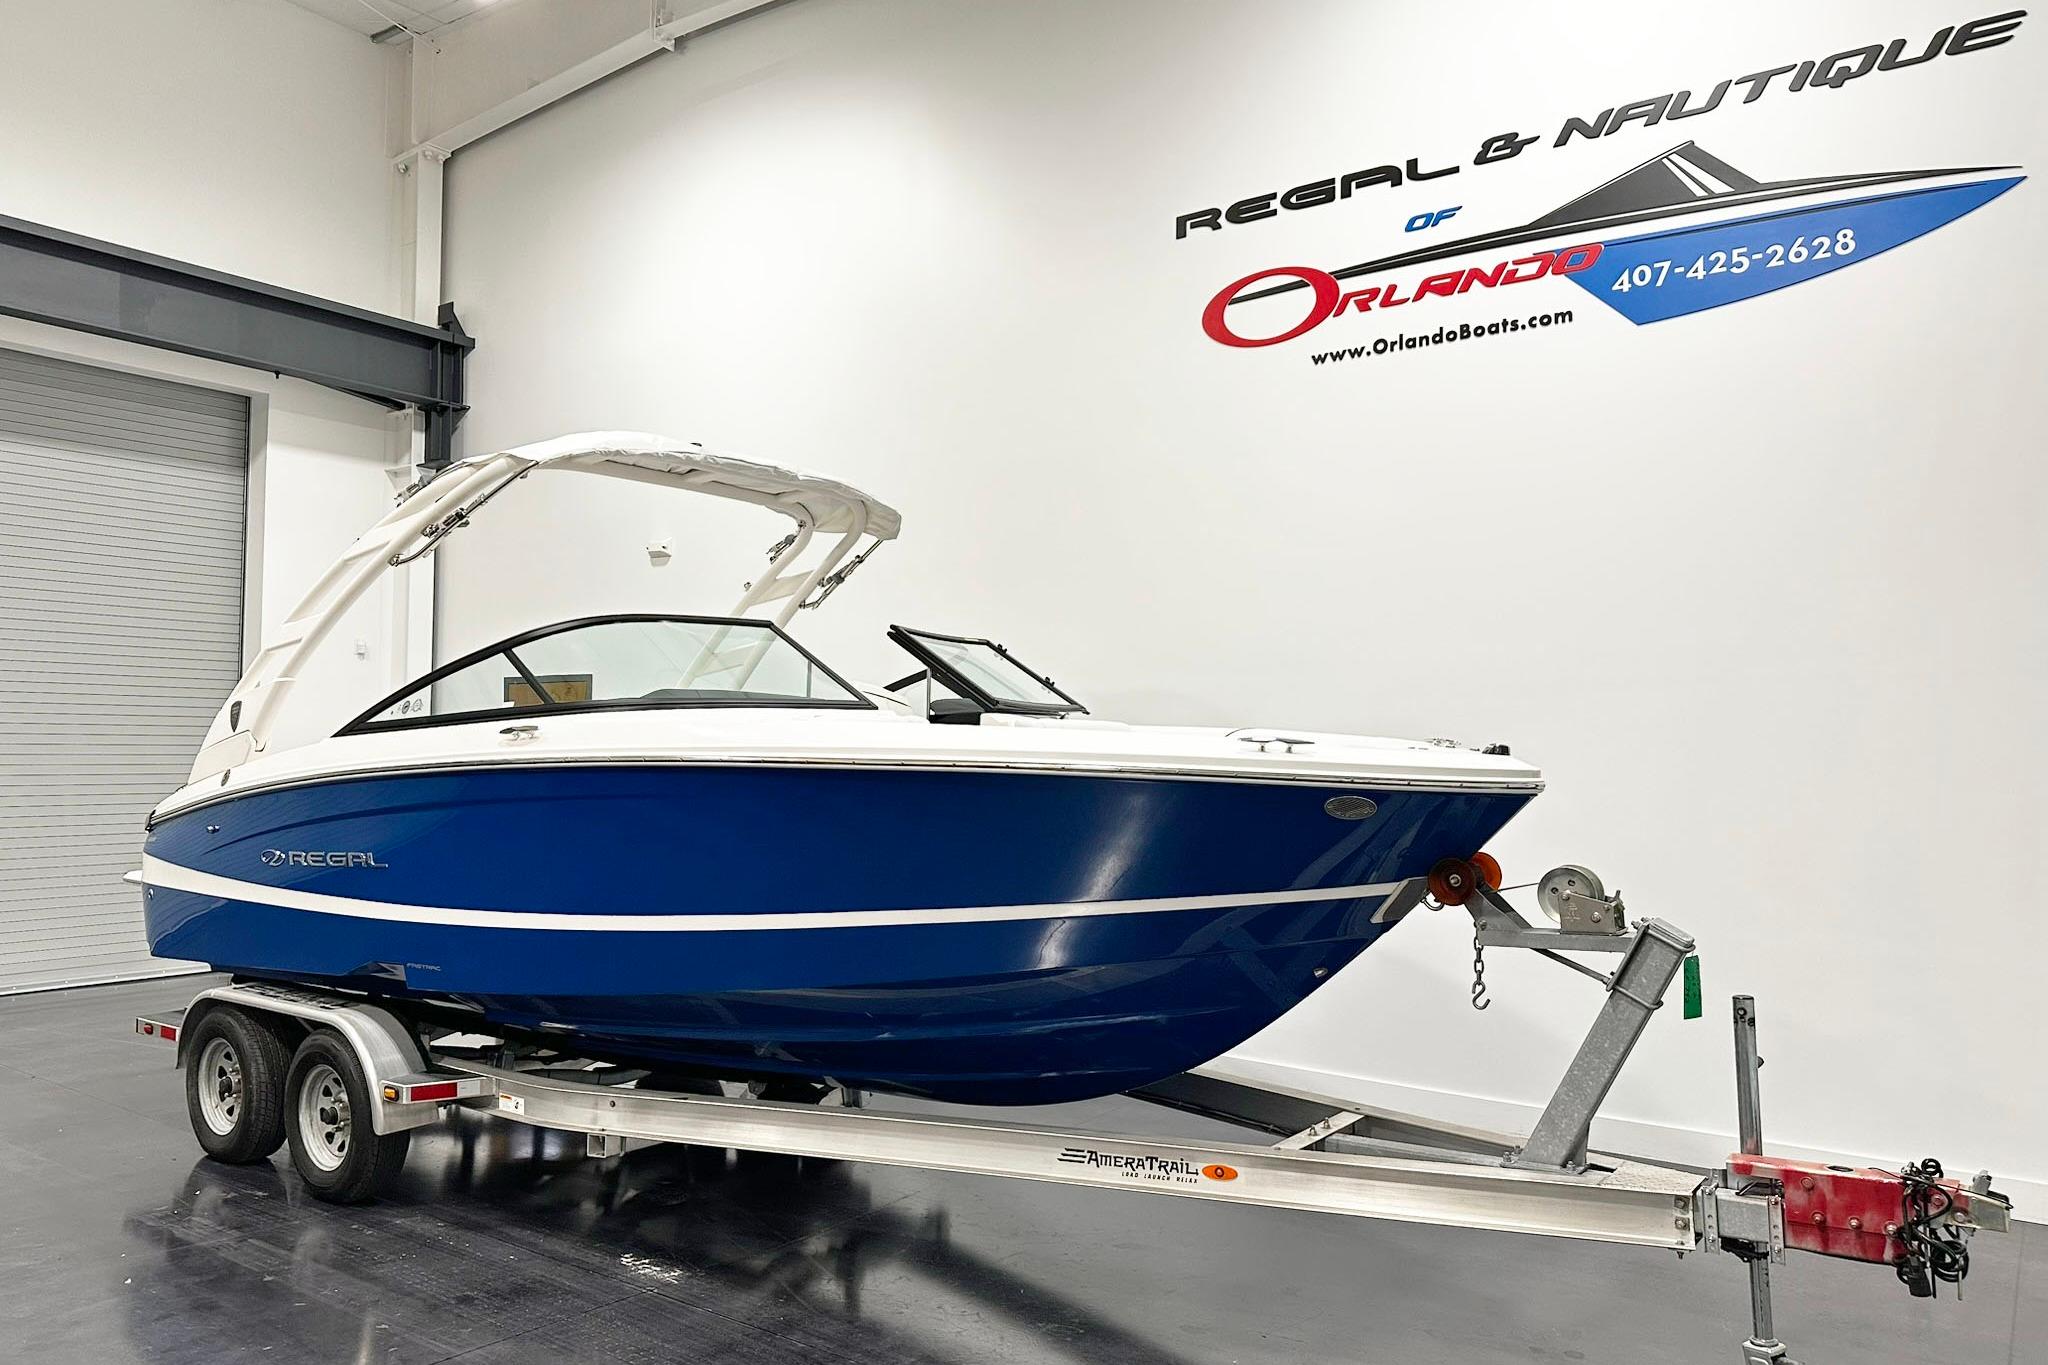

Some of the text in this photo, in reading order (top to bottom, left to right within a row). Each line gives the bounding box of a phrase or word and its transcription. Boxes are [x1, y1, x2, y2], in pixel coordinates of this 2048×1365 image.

[1176, 10, 2028, 240] REGAL & NAUTIQUE
[1404, 205, 1463, 233] OF
[1611, 228, 1857, 294] 407-425-2628
[1201, 242, 1606, 348] ORLANDO
[1310, 309, 1574, 366] www.OrlandoBoats.com
[288, 850, 389, 869] REGAL
[1121, 1171, 1199, 1184] LOAD LAUNCH RELAX
